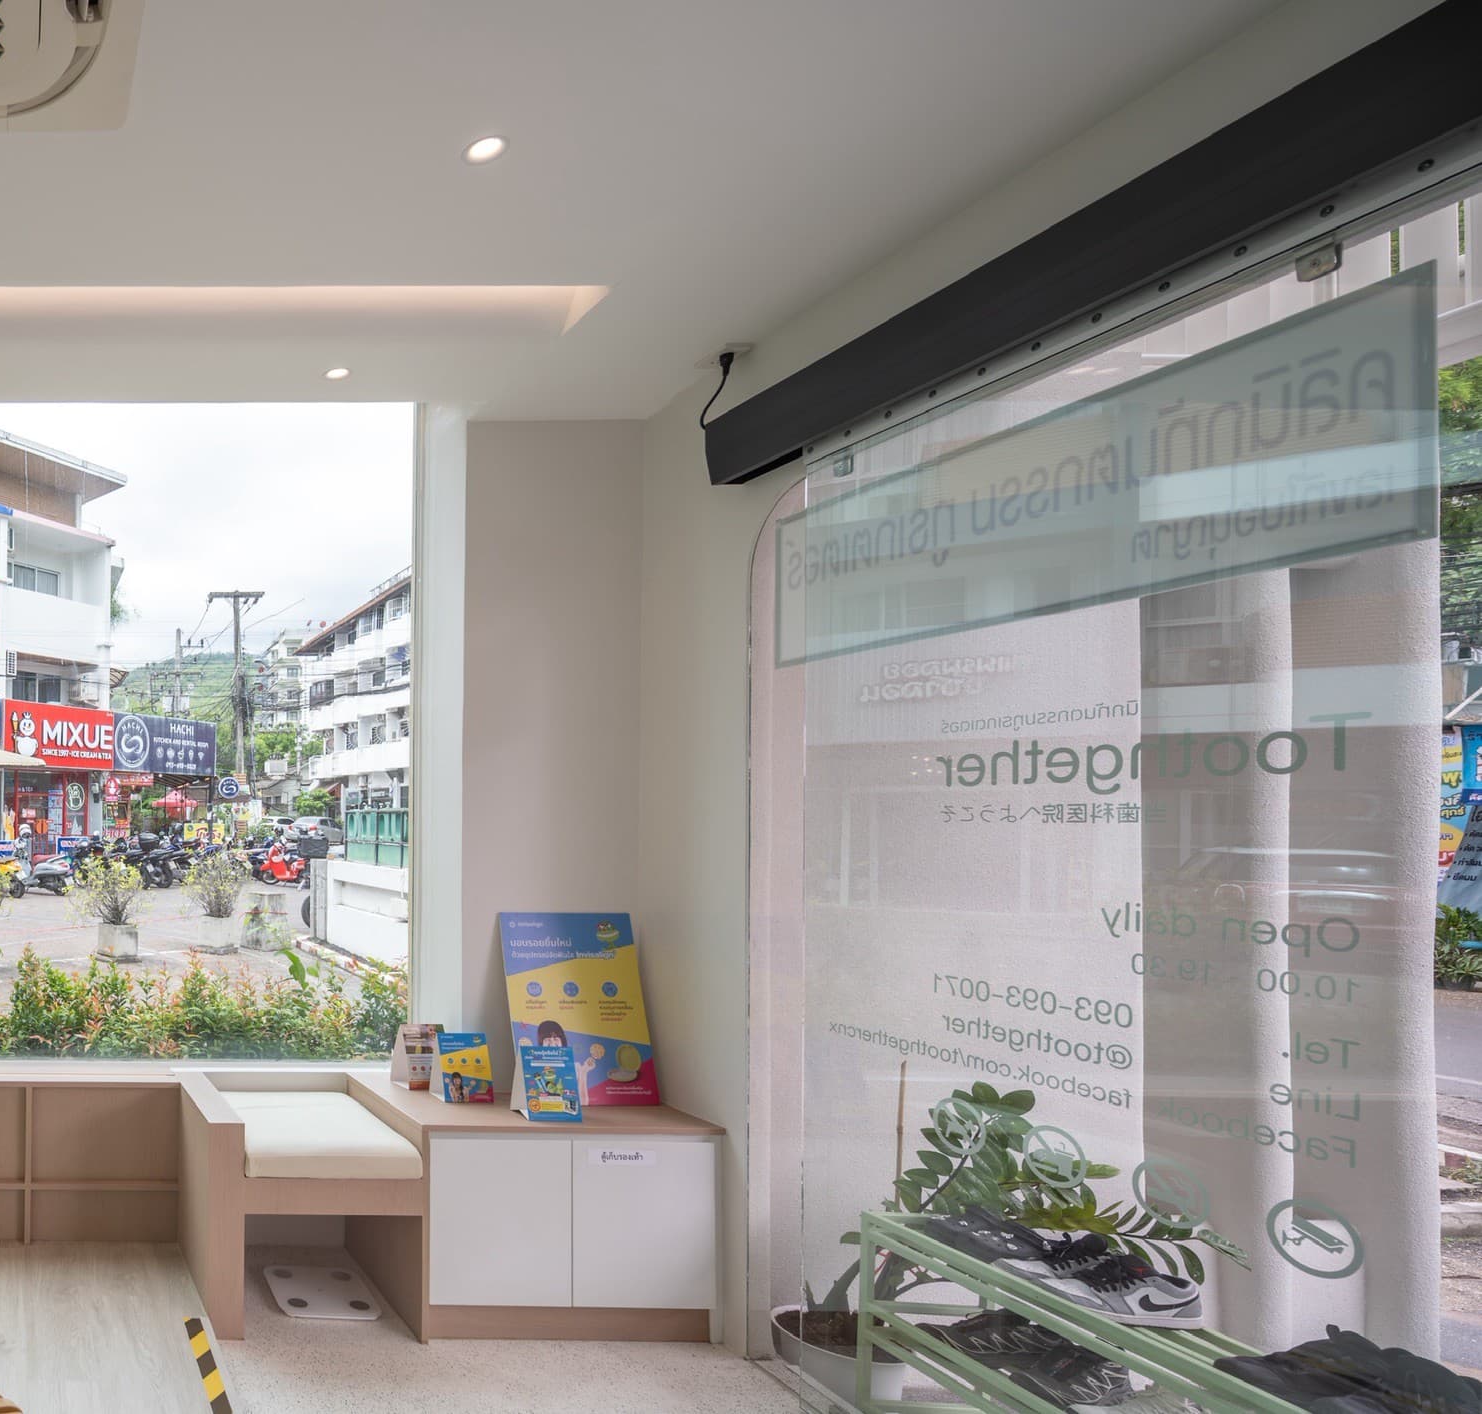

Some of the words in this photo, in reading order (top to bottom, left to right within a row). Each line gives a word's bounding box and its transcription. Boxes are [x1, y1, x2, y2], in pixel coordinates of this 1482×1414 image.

[121, 721, 144, 734] HACHI
[170, 723, 194, 736] HACHI
[42, 719, 113, 750] MIXUE
